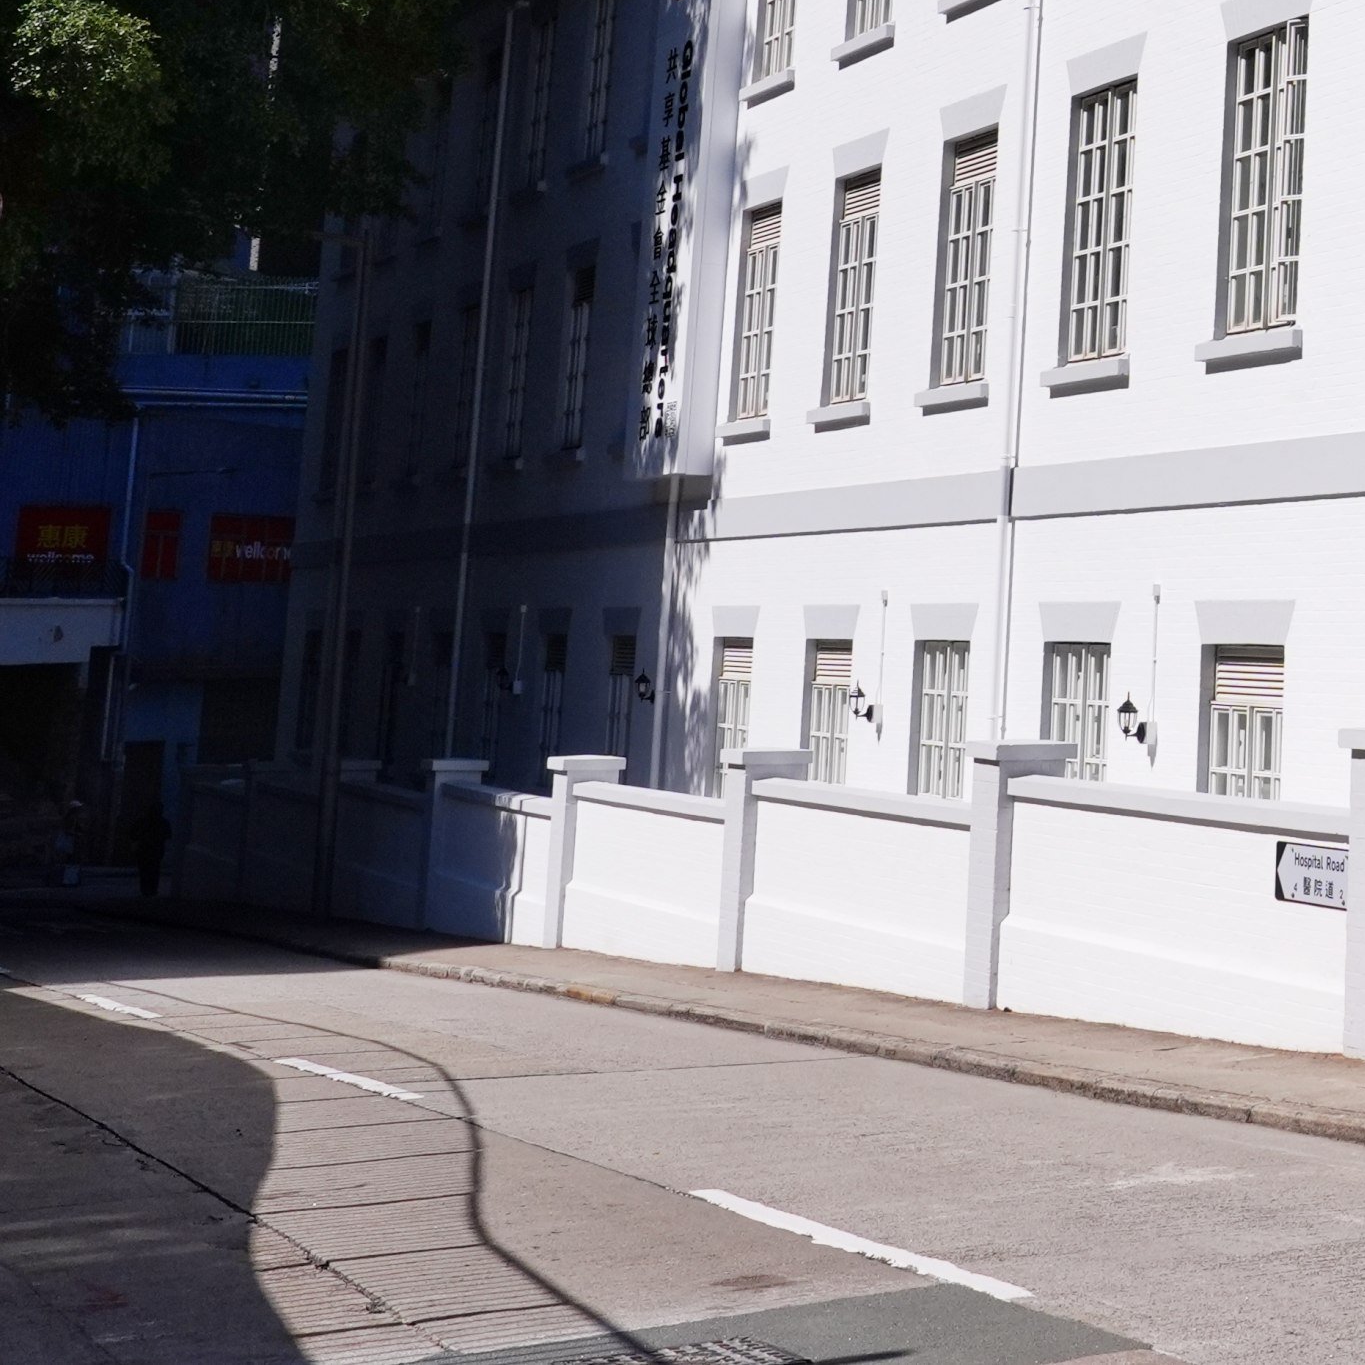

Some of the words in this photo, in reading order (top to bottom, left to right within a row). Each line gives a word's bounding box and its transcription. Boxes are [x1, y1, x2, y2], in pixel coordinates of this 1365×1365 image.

[674, 39, 693, 162] Global
[638, 47, 678, 441] 共享基金會全球總部
[654, 173, 684, 439] Headquarters
[36, 523, 90, 549] 惠康
[1294, 852, 1323, 870] Hospital
[1326, 856, 1345, 872] Road
[1303, 876, 1334, 900] 醫院道
